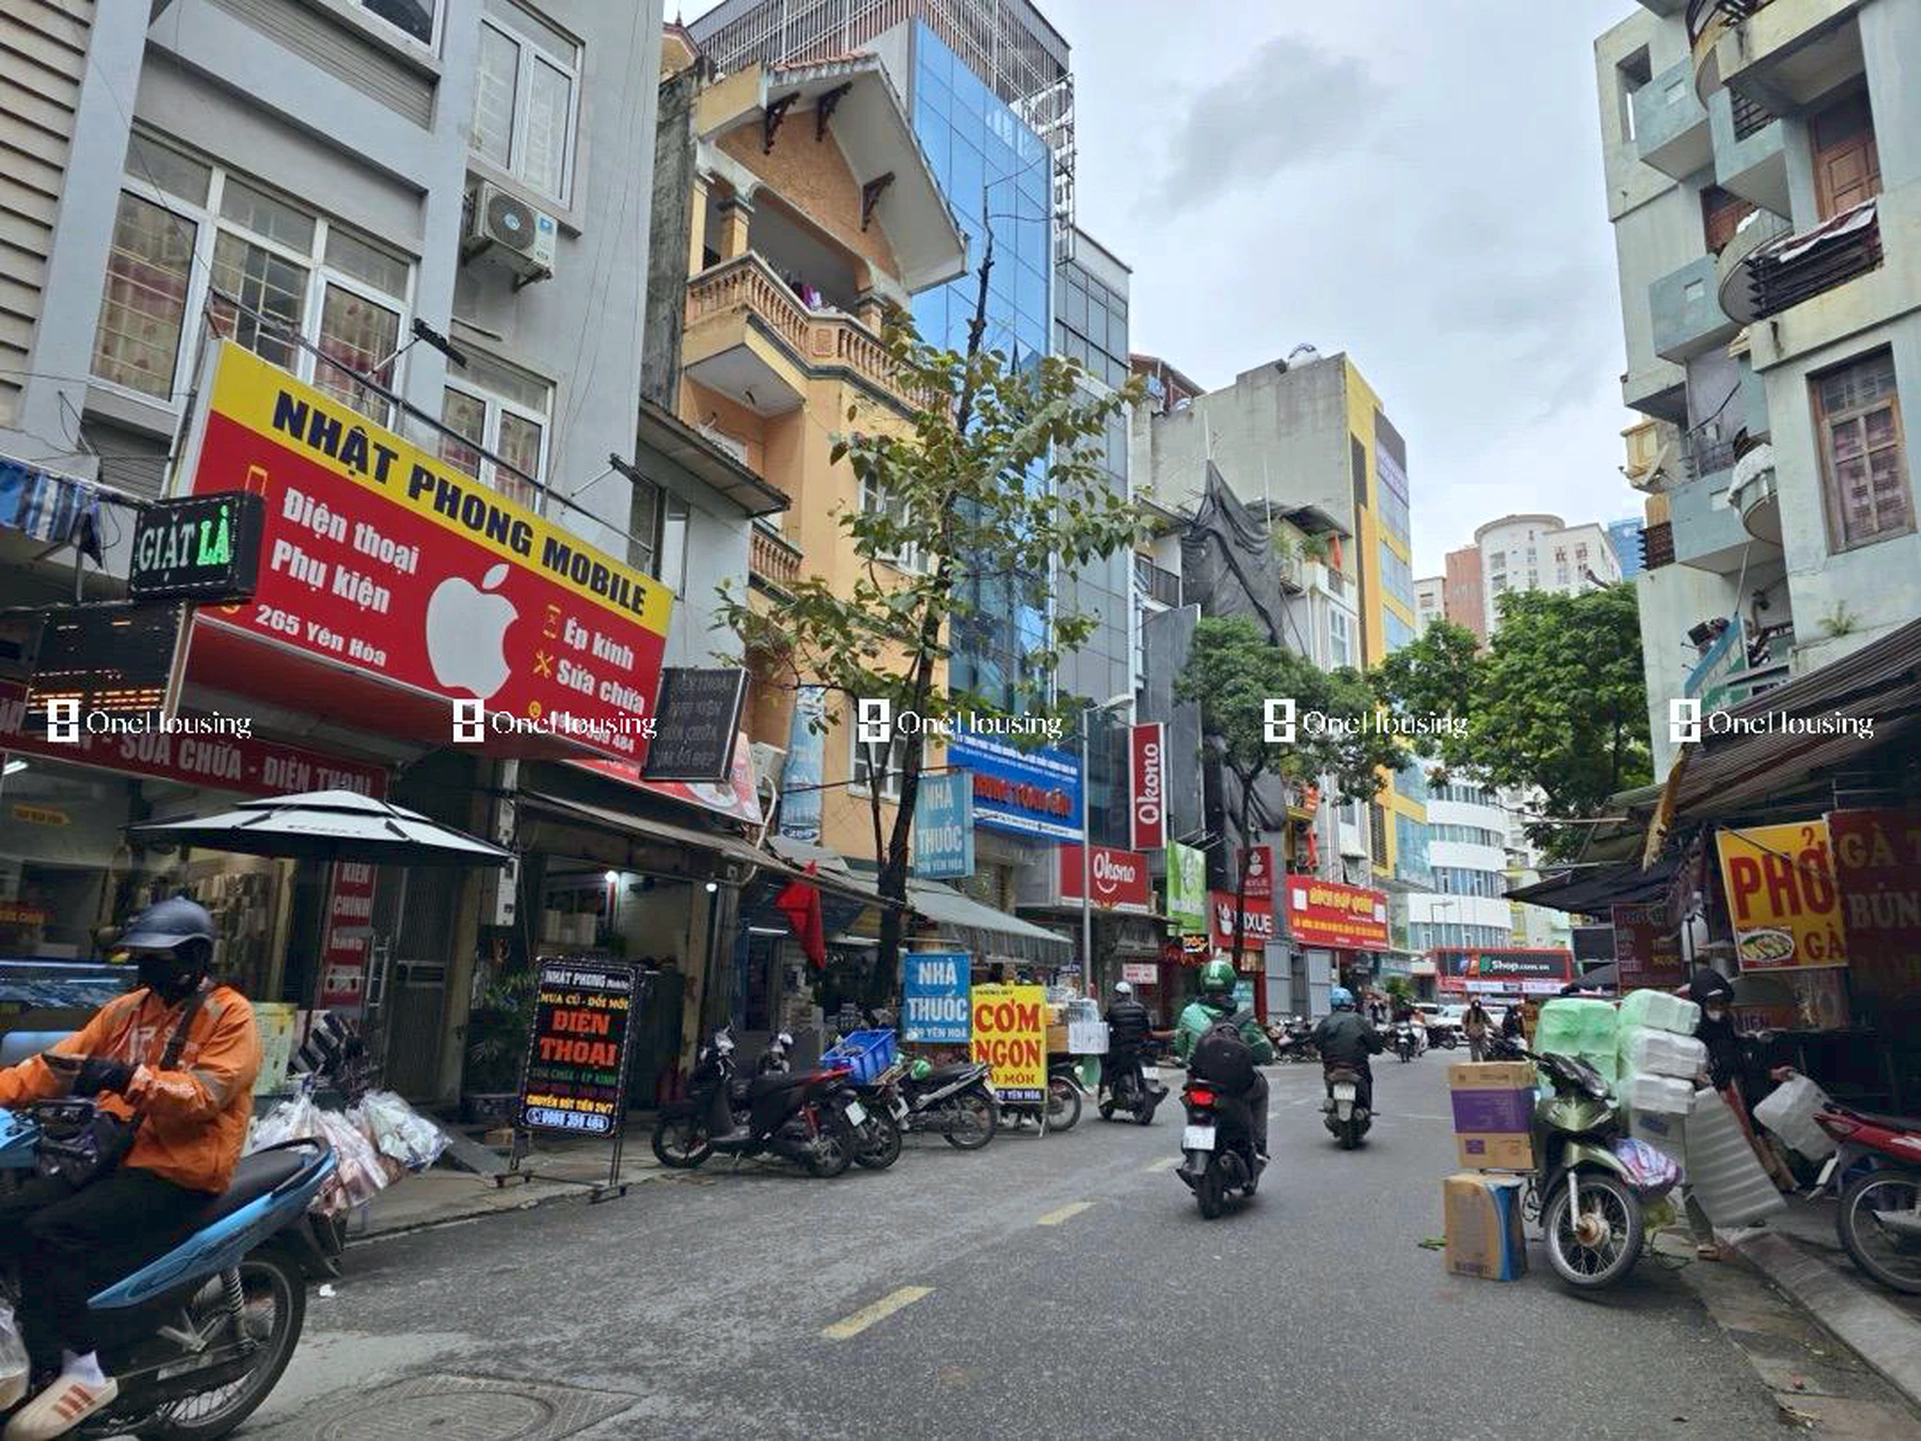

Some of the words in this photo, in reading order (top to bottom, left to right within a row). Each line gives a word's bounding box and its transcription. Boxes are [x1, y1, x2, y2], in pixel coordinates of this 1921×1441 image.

[272, 388, 399, 486] NHẬT
[408, 462, 534, 558] PHONG
[542, 537, 647, 617] MOBILE
[138, 513, 196, 582] GIẶT
[282, 486, 348, 544] Điện
[353, 521, 420, 576] thoại
[270, 537, 328, 593] Phụ
[331, 564, 391, 614] kiện
[255, 603, 301, 636] 265
[306, 621, 345, 652] Yên
[563, 616, 588, 650] Ép
[592, 630, 635, 672] kính
[556, 658, 596, 696] Sửa
[600, 680, 646, 716] chữa
[178, 738, 242, 781] CHỮA
[924, 777, 954, 812] NHÀ
[1138, 742, 1160, 825] Okono
[917, 816, 963, 855] THUỐC
[1093, 853, 1136, 884] Okono
[1803, 922, 1845, 961] GÀ
[918, 956, 958, 986] NHÀ
[552, 1008, 611, 1037] ĐIỆN
[906, 989, 968, 1022] THUỐC
[973, 997, 1042, 1034] CƠM
[540, 1037, 618, 1070] THOẠI
[973, 1038, 1042, 1069] NGON
